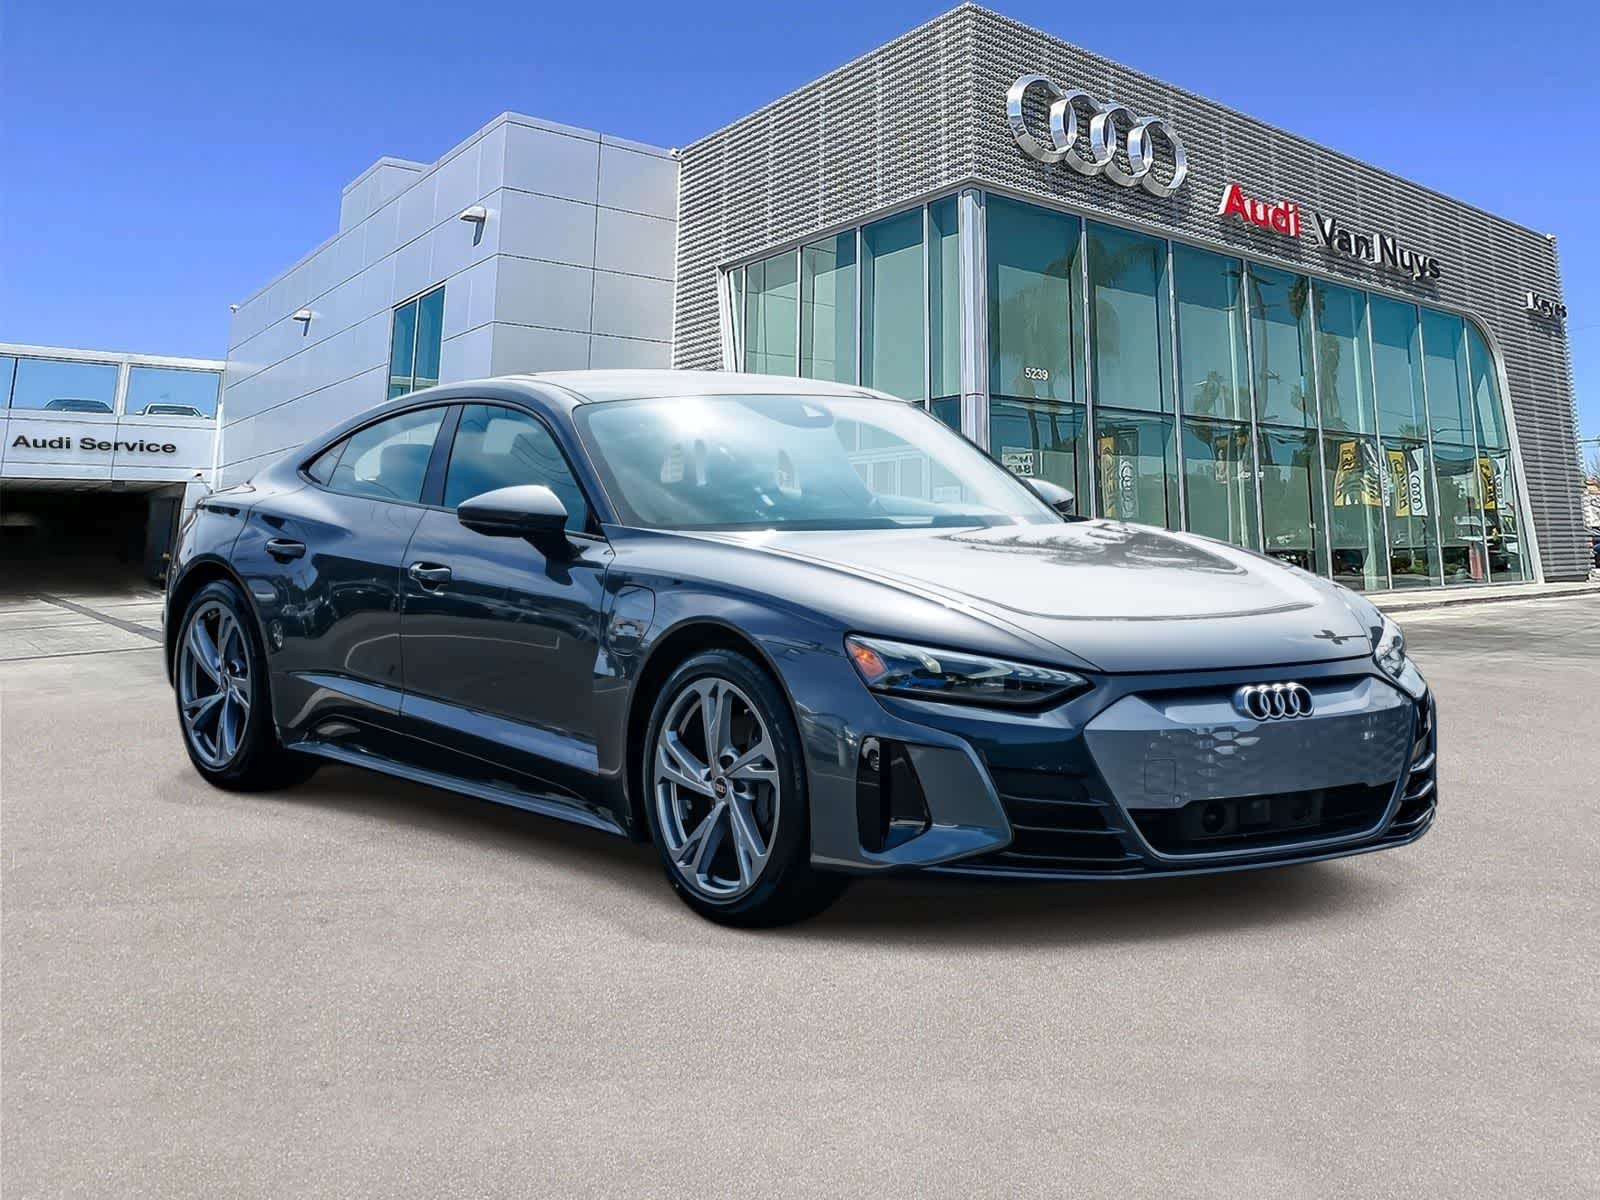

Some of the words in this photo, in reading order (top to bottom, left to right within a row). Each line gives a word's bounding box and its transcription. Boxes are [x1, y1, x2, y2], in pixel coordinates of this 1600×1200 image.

[1218, 183, 1302, 237] Audi
[1311, 211, 1375, 259] Van
[1373, 233, 1441, 280] Nuys
[1024, 367, 1049, 381] 5239
[12, 435, 71, 450] Audi
[79, 437, 177, 454] Service
